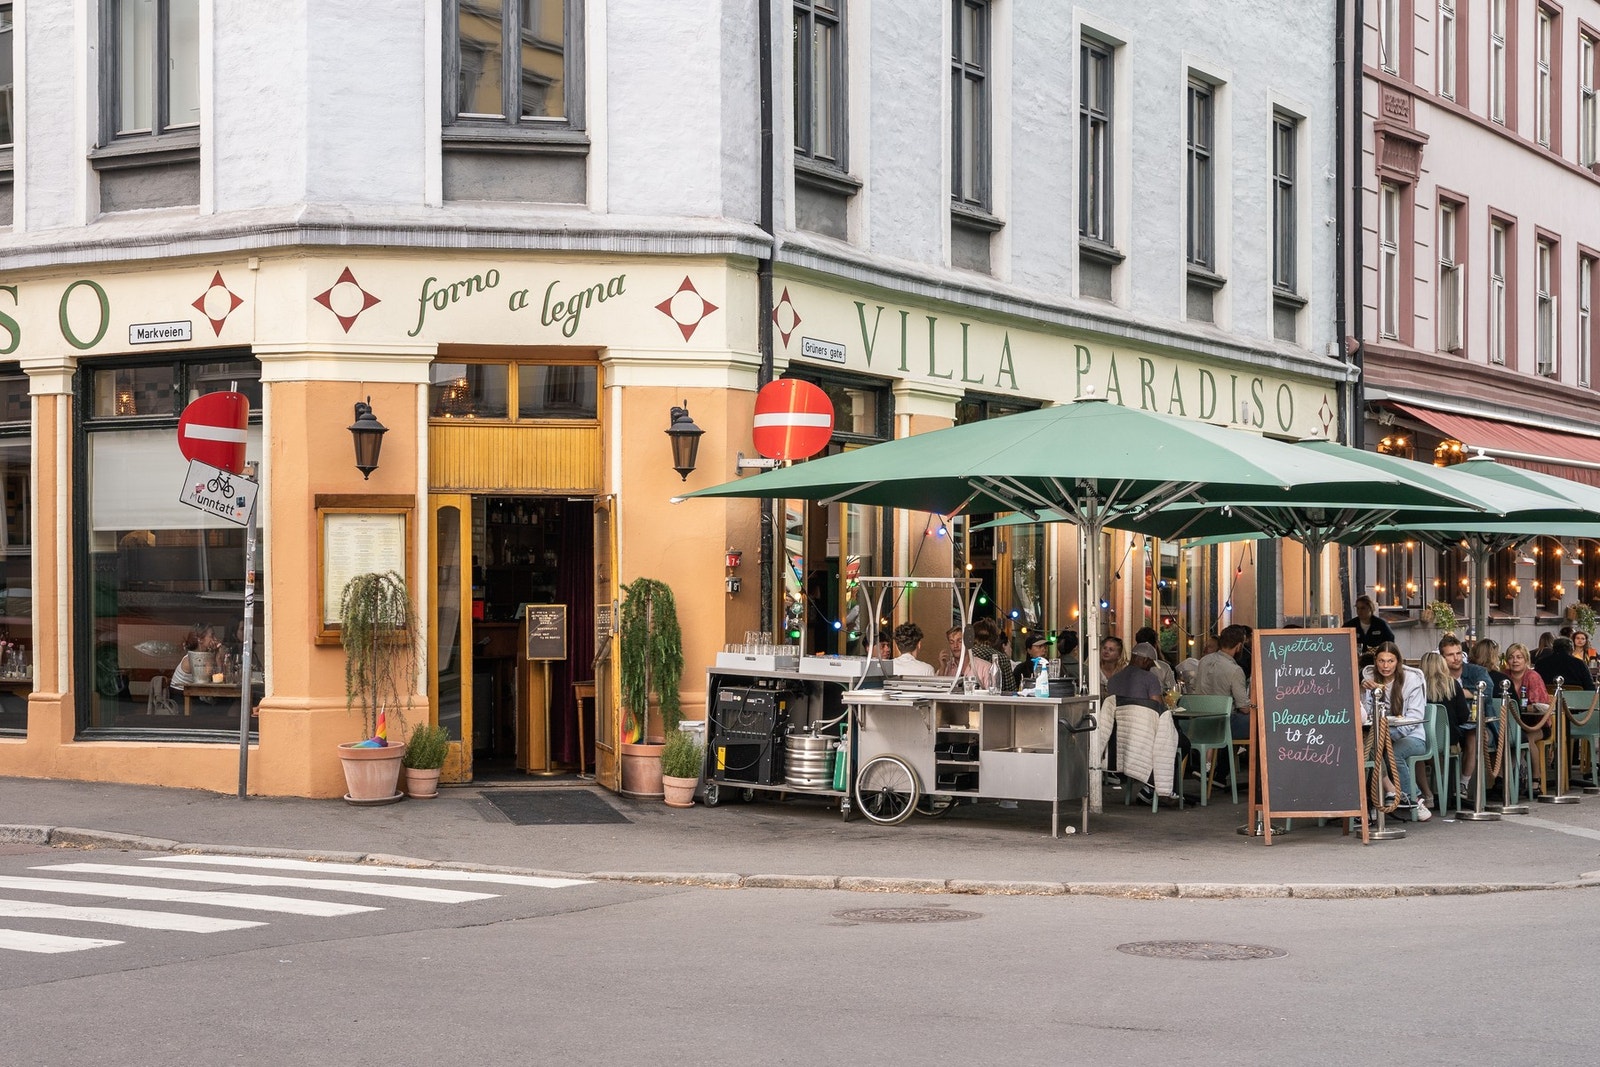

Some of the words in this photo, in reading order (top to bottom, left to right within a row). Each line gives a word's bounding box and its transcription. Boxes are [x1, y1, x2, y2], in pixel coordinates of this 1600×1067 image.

[407, 269, 501, 338] forno
[508, 288, 529, 312] a
[541, 273, 627, 338] legna
[136, 326, 184, 340] Markveien
[829, 348, 843, 360] gate
[854, 300, 1020, 391] VILLA
[1073, 343, 1295, 433] PARADISO
[1268, 636, 1335, 664] Aspettare
[1274, 663, 1316, 688] prima
[1319, 659, 1336, 675] di
[1318, 708, 1350, 725] wait
[1285, 727, 1303, 742] to
[1305, 727, 1325, 745] be
